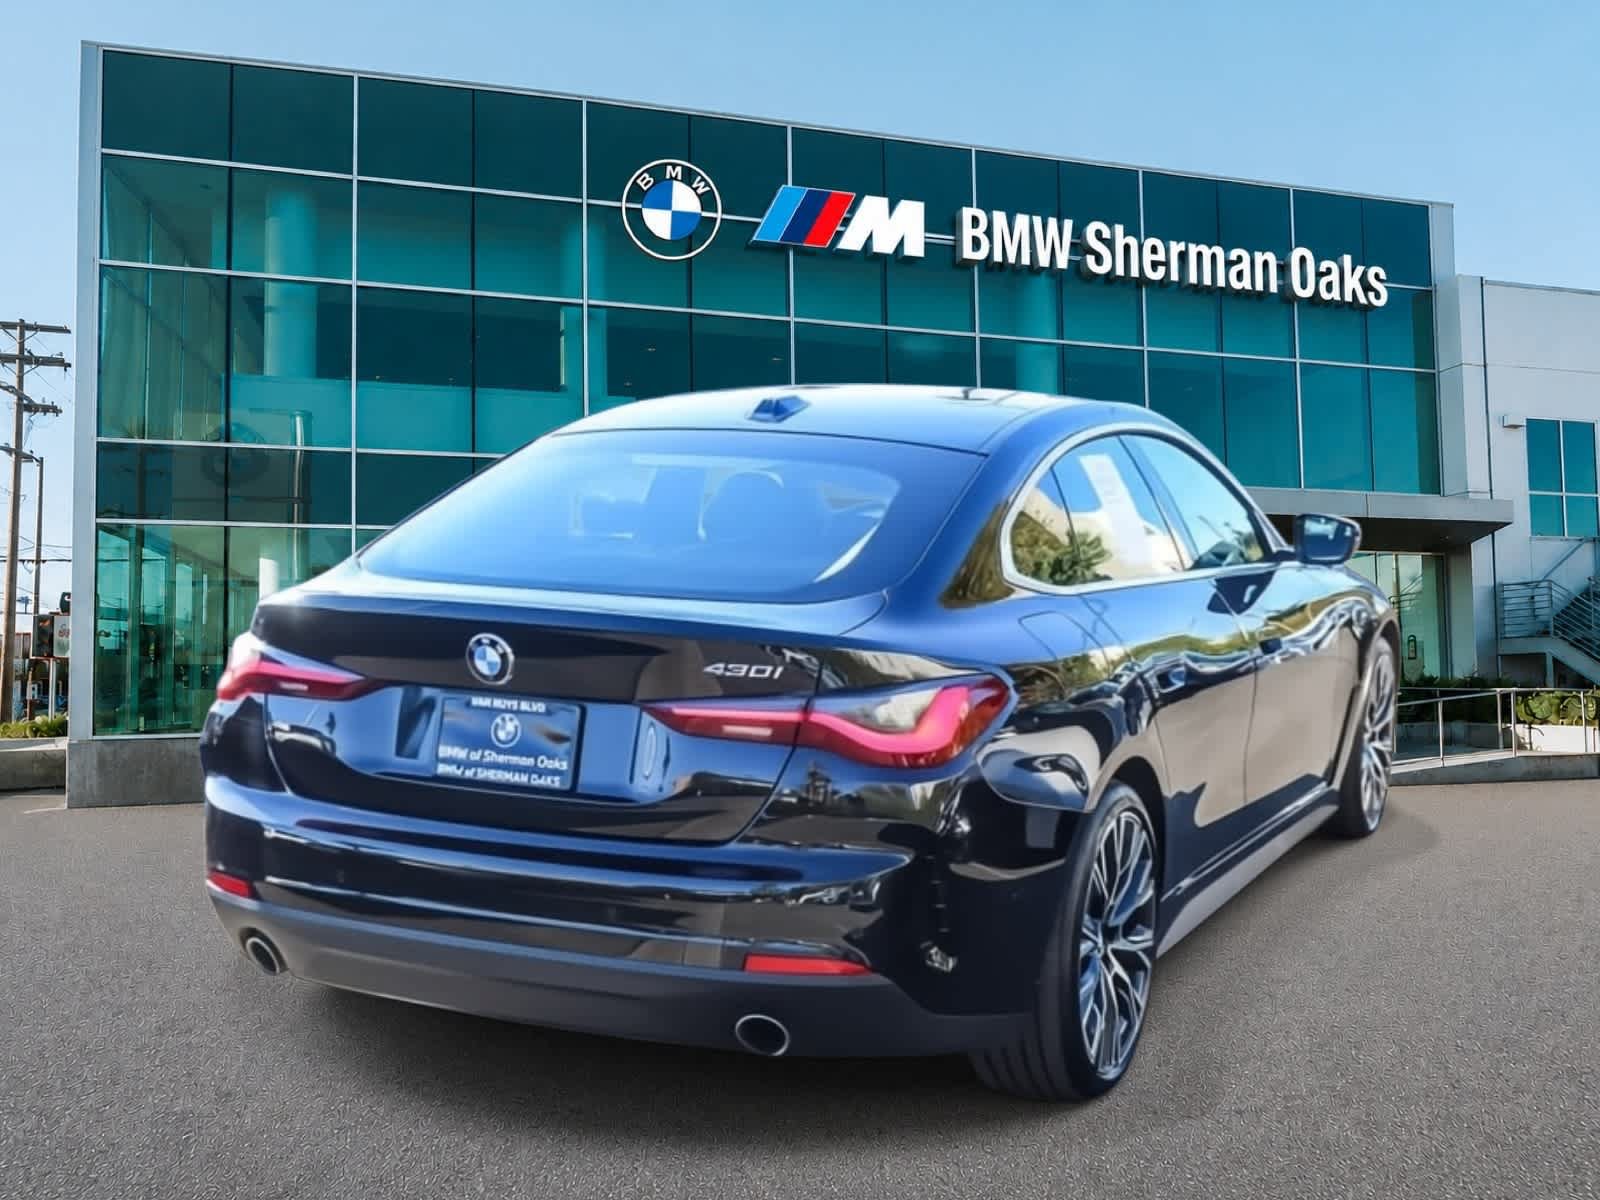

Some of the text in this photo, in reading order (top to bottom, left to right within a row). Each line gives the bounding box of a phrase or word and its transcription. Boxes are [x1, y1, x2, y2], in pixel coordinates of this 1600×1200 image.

[636, 165, 711, 195] BMW
[835, 195, 925, 257] M
[961, 207, 1389, 308] BMW Sherman Oaks
[438, 744, 568, 771] BMW of Sherman Oaks
[465, 767, 475, 779] of
[476, 767, 529, 784] SHERMAN
[530, 774, 561, 788] OAKS
